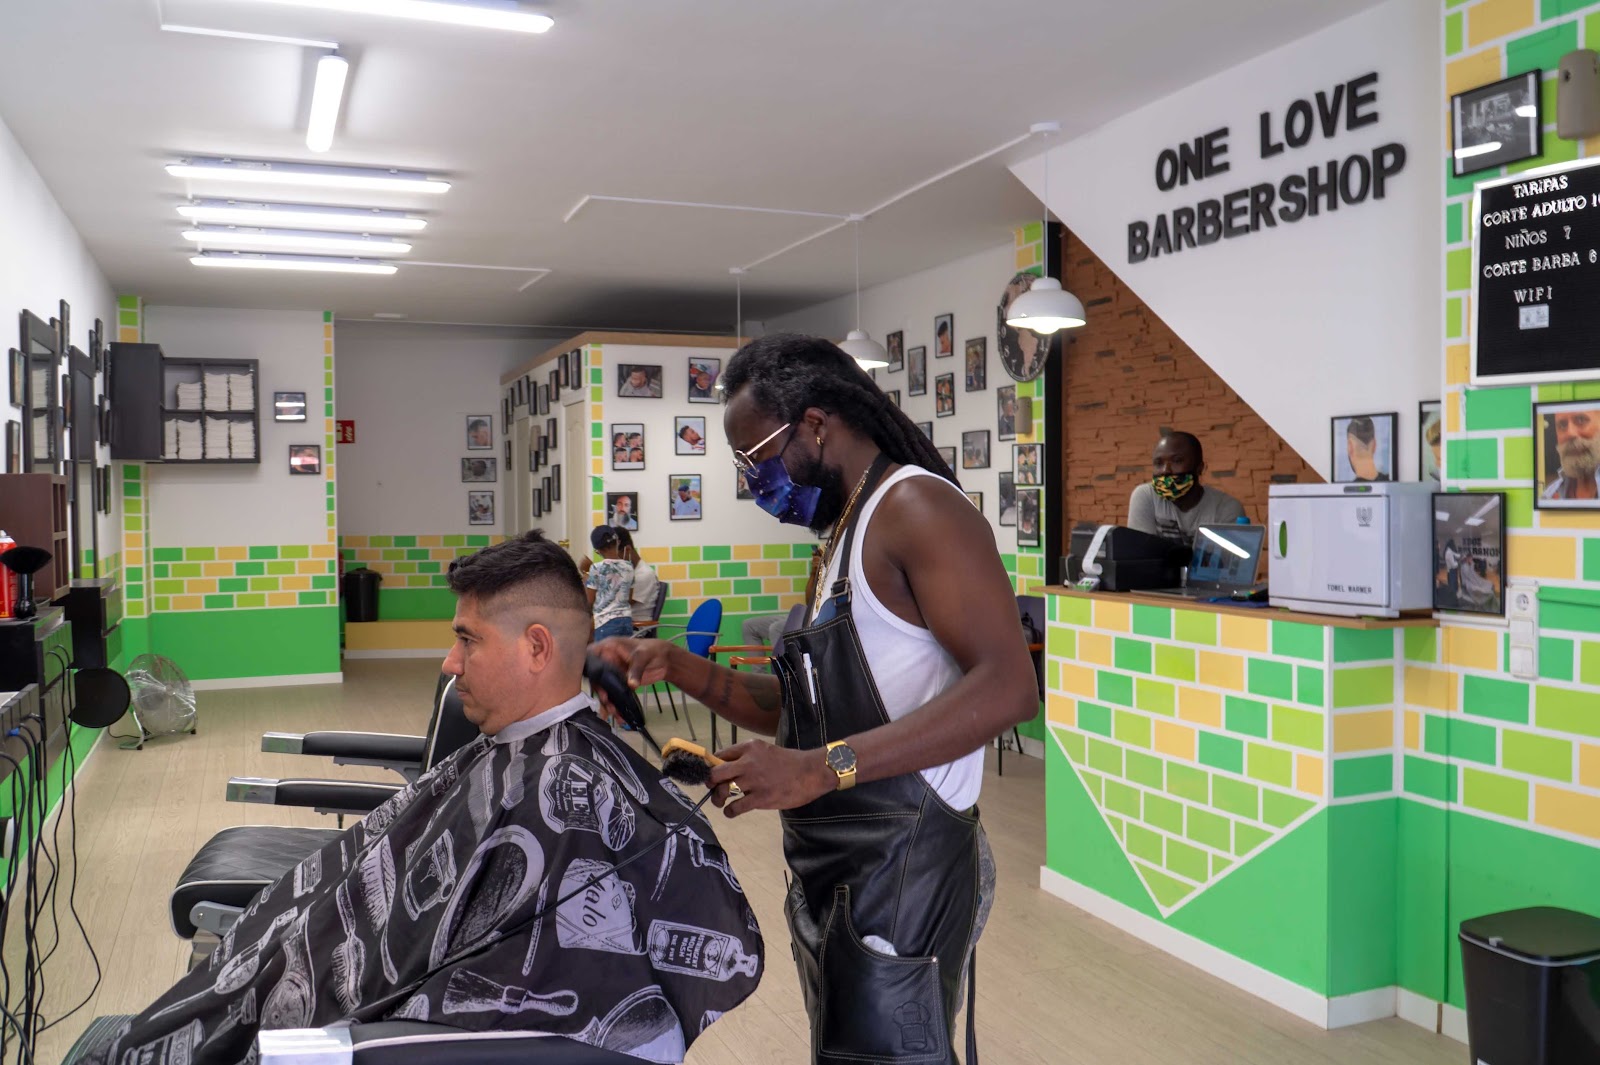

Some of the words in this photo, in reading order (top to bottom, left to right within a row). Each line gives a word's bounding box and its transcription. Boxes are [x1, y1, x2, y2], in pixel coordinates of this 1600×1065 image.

[1156, 127, 1230, 191] ONE
[1260, 72, 1379, 159] LOVE
[1128, 143, 1406, 264] BARBERSHOP
[1483, 206, 1527, 227] CORTE
[1532, 195, 1587, 218] ADULTO
[1505, 229, 1547, 249] NIÑOS
[1563, 225, 1571, 239] 7
[1483, 259, 1526, 278] CORTE
[1532, 251, 1580, 271] BARBA
[1589, 249, 1597, 263] 6
[1513, 285, 1552, 303] WIFI
[1327, 583, 1345, 593] TOWEL
[1348, 585, 1372, 595] WARMER
[679, 937, 689, 957] WASH
[685, 935, 697, 964] MOUTH
